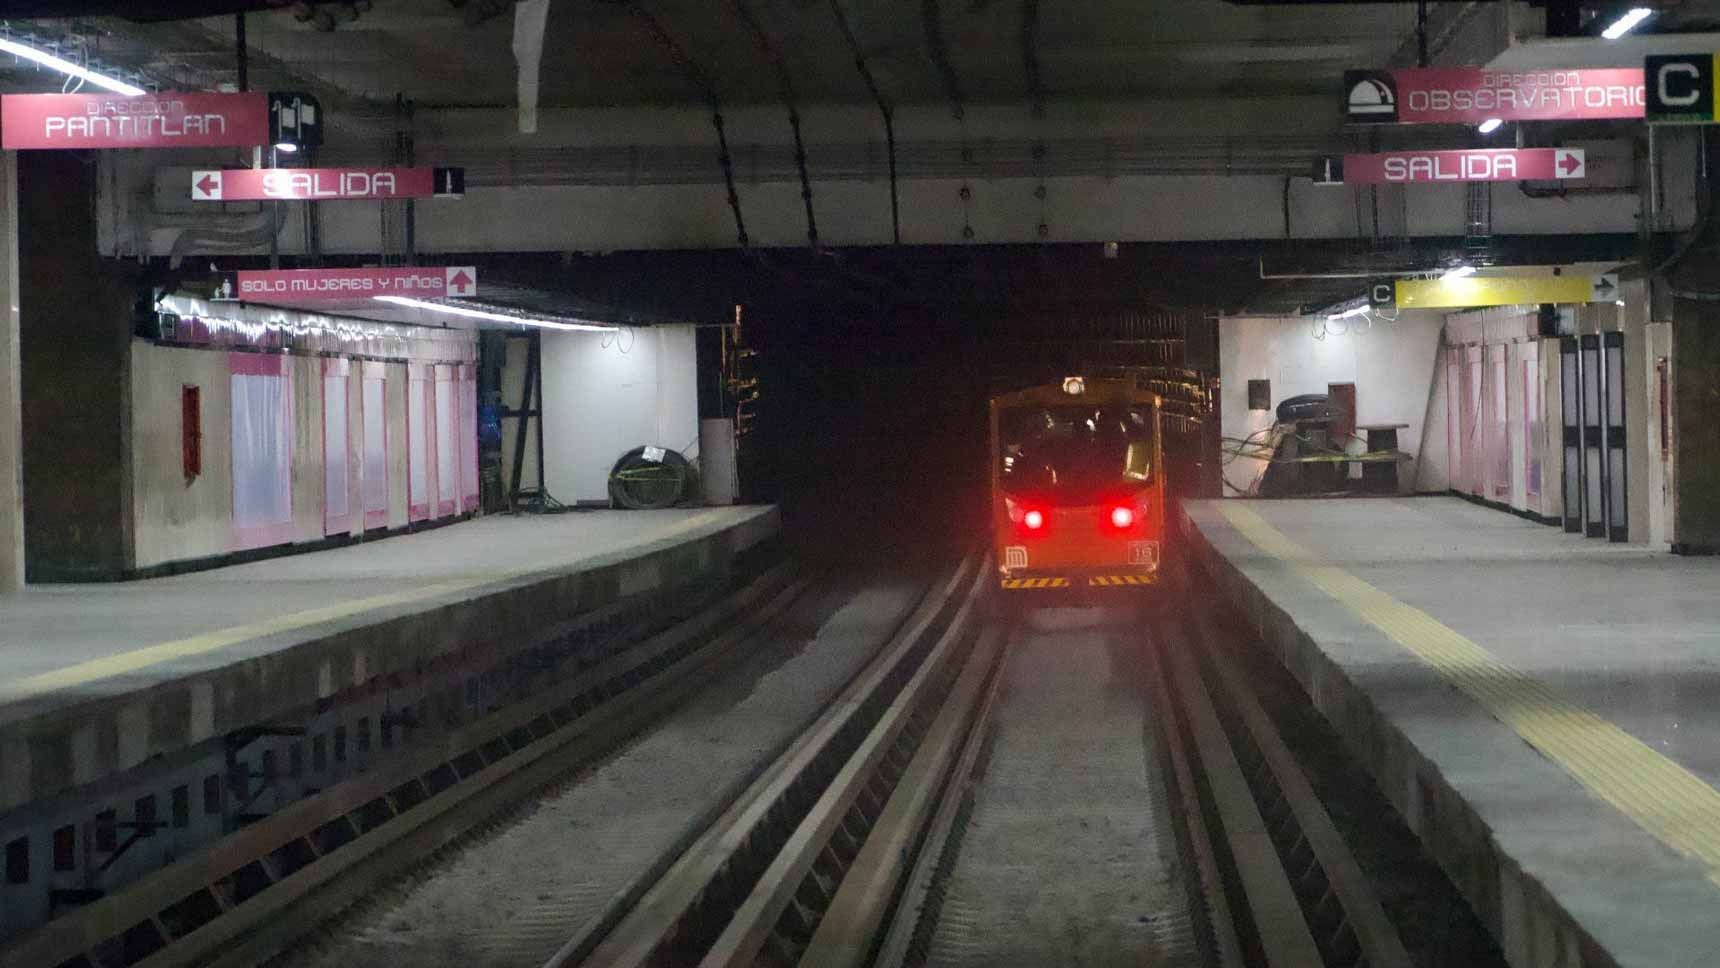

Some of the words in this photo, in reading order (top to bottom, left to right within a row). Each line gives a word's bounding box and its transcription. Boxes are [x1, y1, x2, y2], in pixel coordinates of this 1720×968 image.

[1658, 63, 1700, 106] C
[45, 115, 225, 137] PANTITLAN
[1384, 154, 1517, 179] SALIDA
[262, 172, 396, 196] SALIDA
[241, 280, 287, 292] SOLO
[291, 278, 373, 291] MUJERES
[378, 279, 389, 289] Y
[394, 275, 443, 289] NIÑOS
[1373, 285, 1391, 302] C
